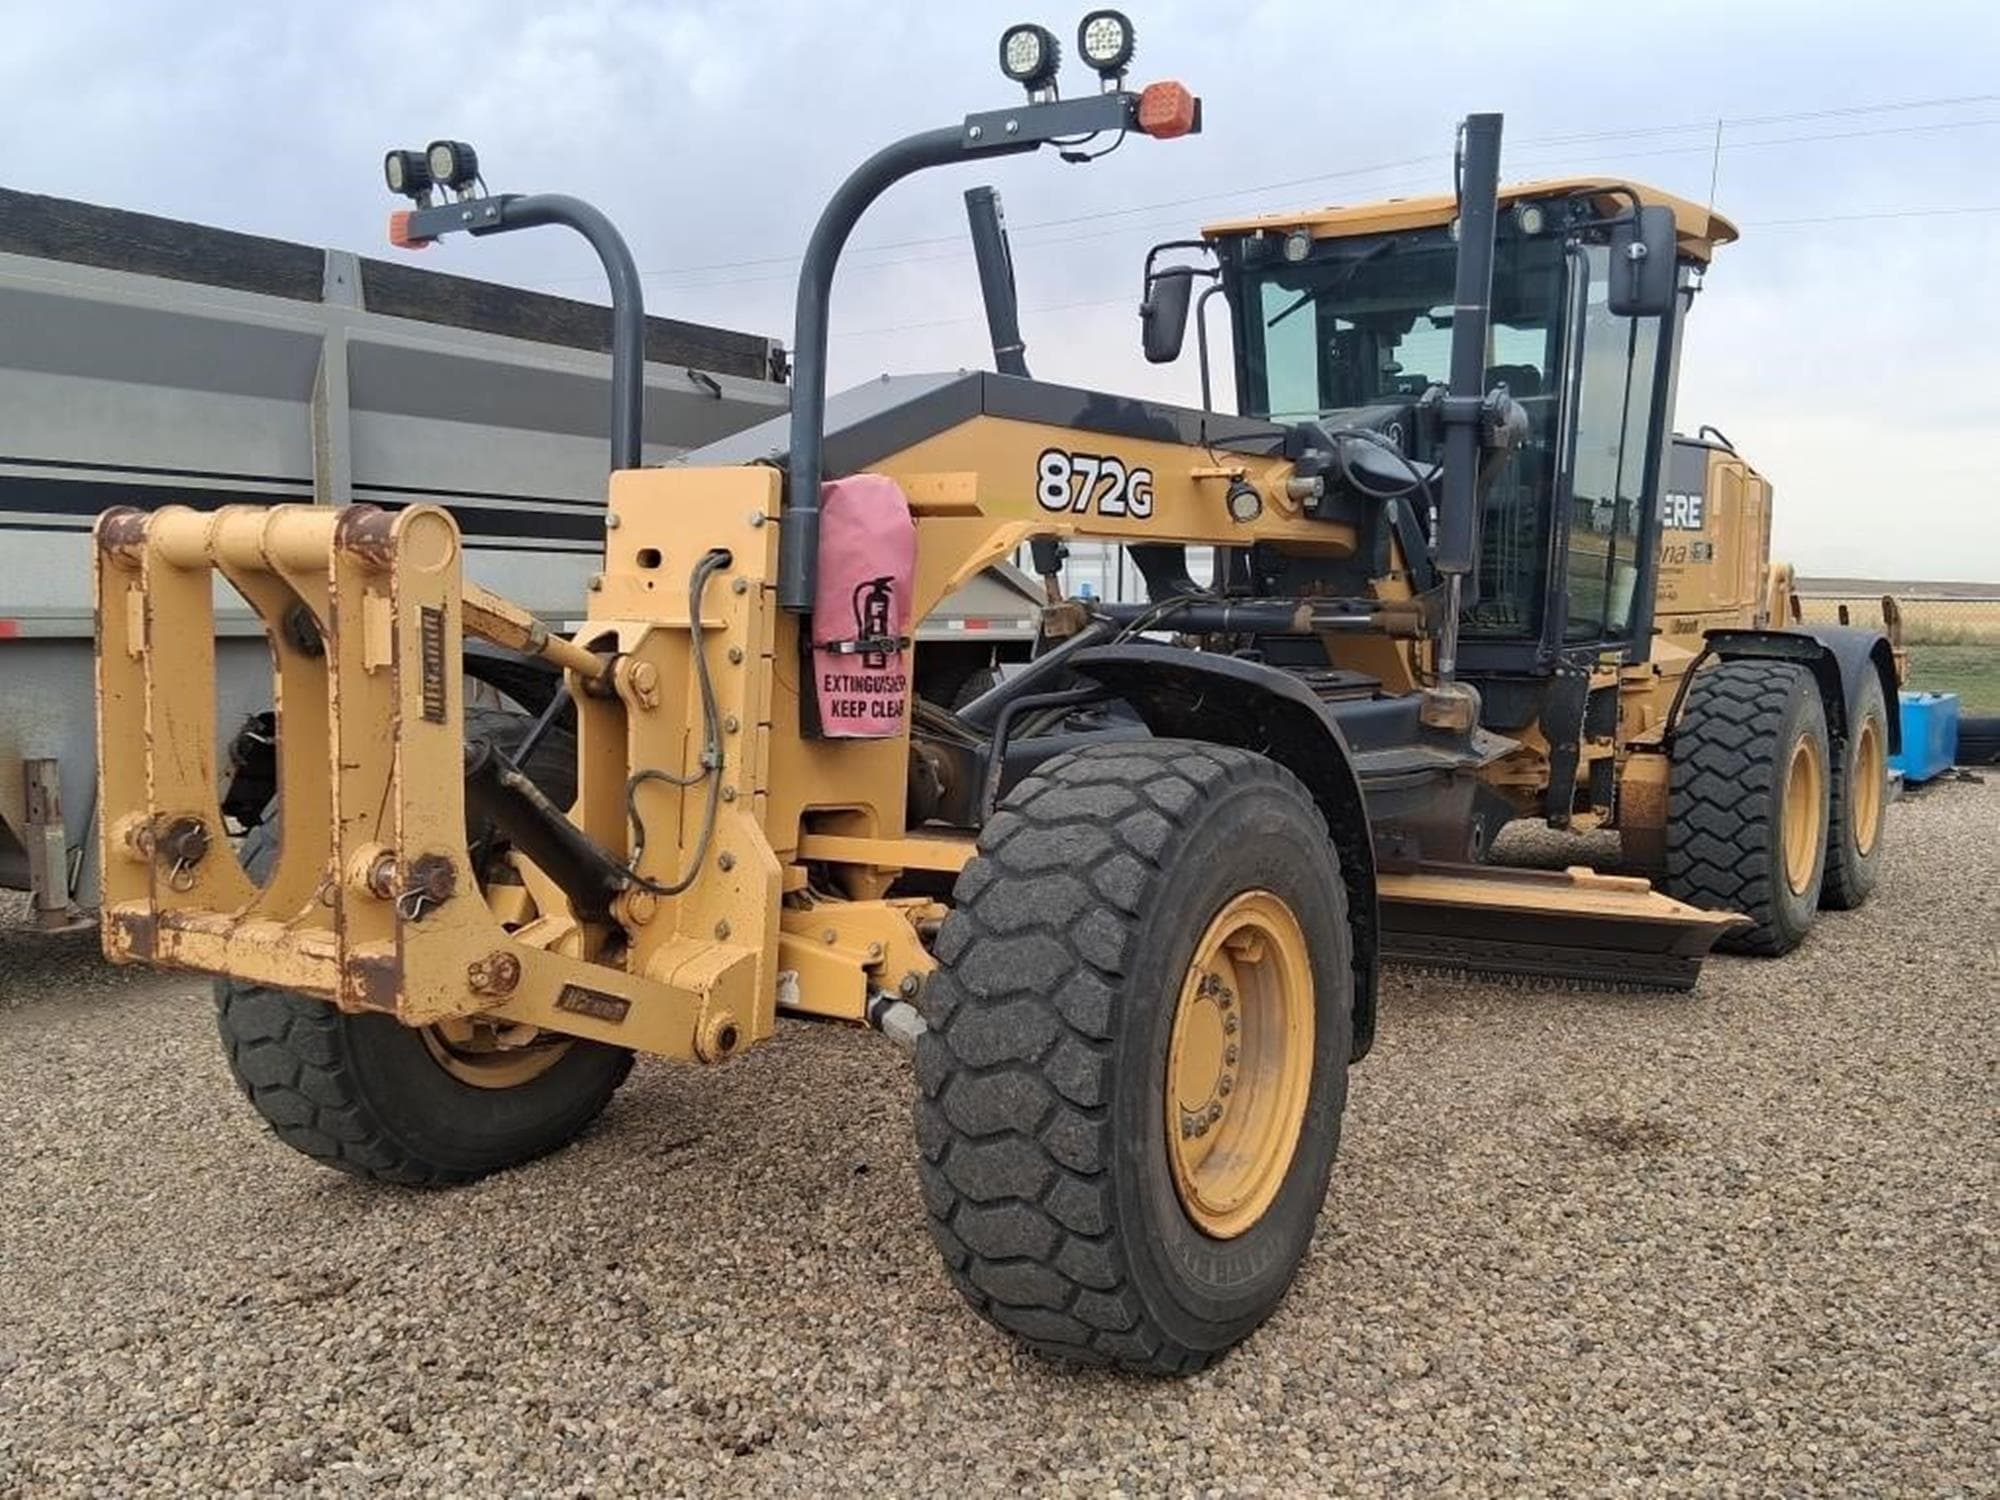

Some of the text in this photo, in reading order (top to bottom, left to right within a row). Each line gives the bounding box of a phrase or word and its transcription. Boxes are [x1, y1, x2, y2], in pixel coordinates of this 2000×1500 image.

[1036, 448, 1153, 519] 872G
[869, 601, 884, 665] FIE
[831, 699, 867, 718] KEEP
